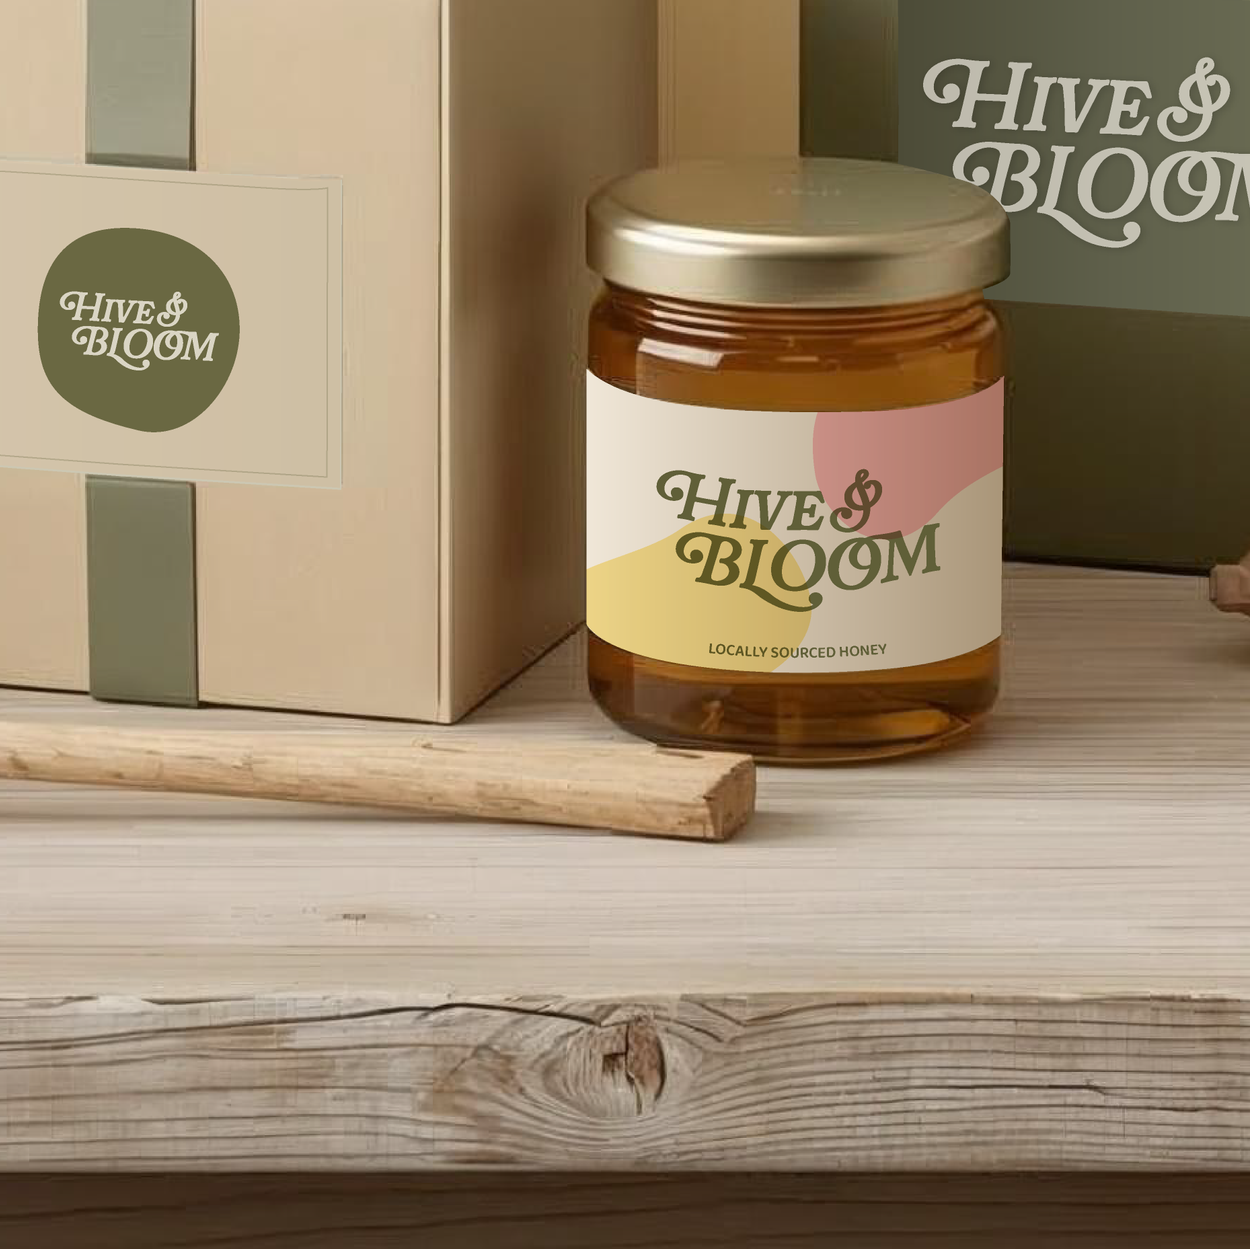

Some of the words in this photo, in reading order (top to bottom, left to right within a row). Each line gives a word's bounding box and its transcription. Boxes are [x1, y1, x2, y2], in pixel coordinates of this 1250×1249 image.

[71, 325, 220, 371] BLOOM
[675, 522, 941, 613] BLOOM
[708, 642, 768, 658] LOCALLY
[770, 646, 836, 659] SOURCED
[839, 643, 887, 658] HONEY
